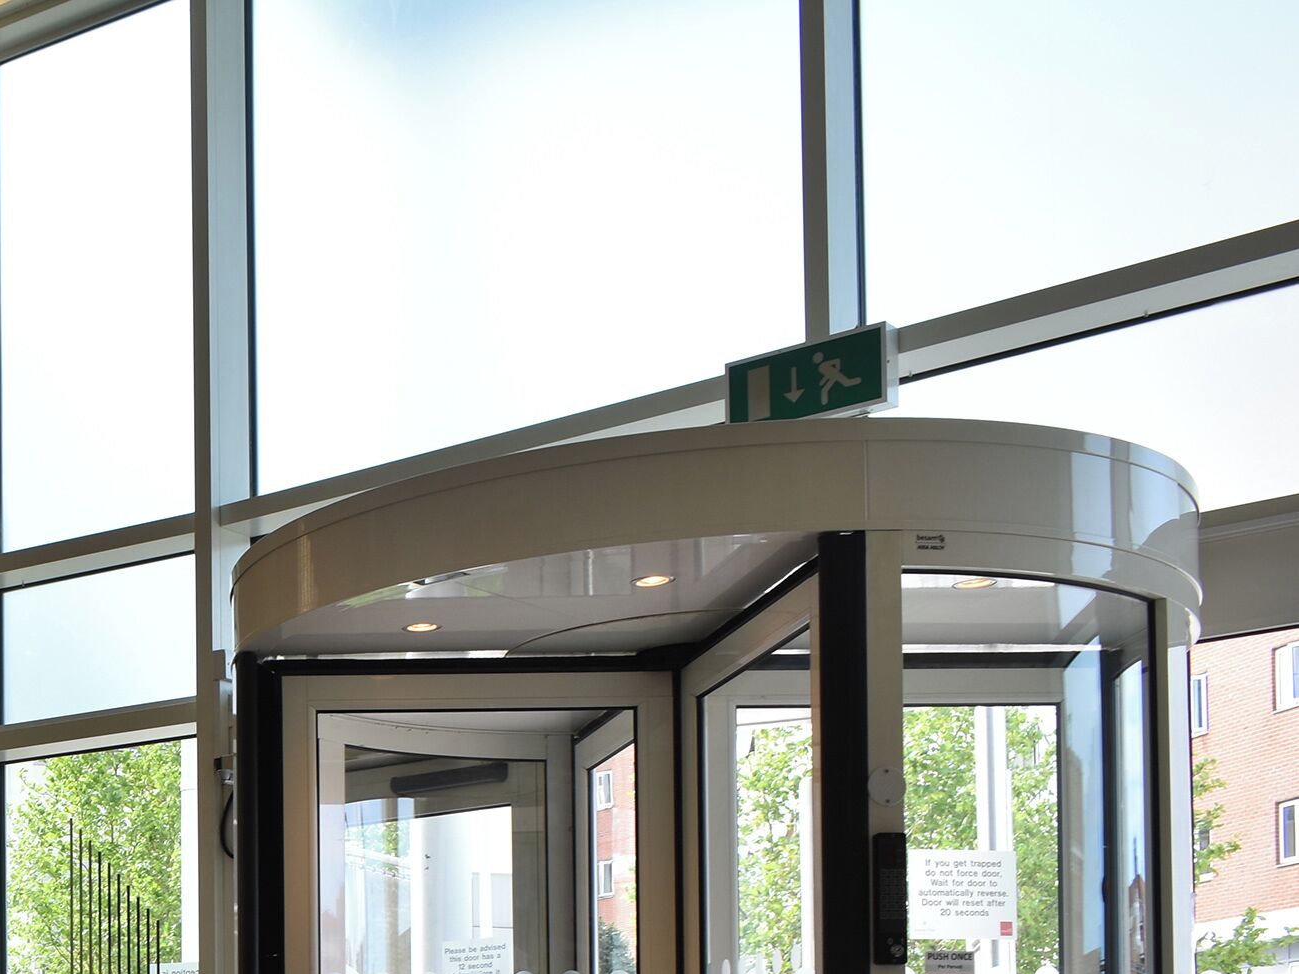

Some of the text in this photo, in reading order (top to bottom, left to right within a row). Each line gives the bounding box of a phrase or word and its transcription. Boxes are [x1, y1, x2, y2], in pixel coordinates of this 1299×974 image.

[935, 860, 950, 868] you
[953, 859, 967, 868] get
[970, 859, 1002, 868] trapped
[925, 869, 936, 877] do
[957, 869, 978, 877] force
[930, 879, 948, 887] Wait
[952, 879, 964, 887] for
[967, 879, 986, 887] door
[918, 889, 974, 898] automatically
[921, 898, 942, 906] Door
[962, 899, 984, 907] reset
[986, 899, 1006, 907] after
[940, 908, 951, 916] 20
[480, 943, 506, 952] advised
[927, 952, 973, 961] PUSH ONCE
[468, 962, 493, 970] second
